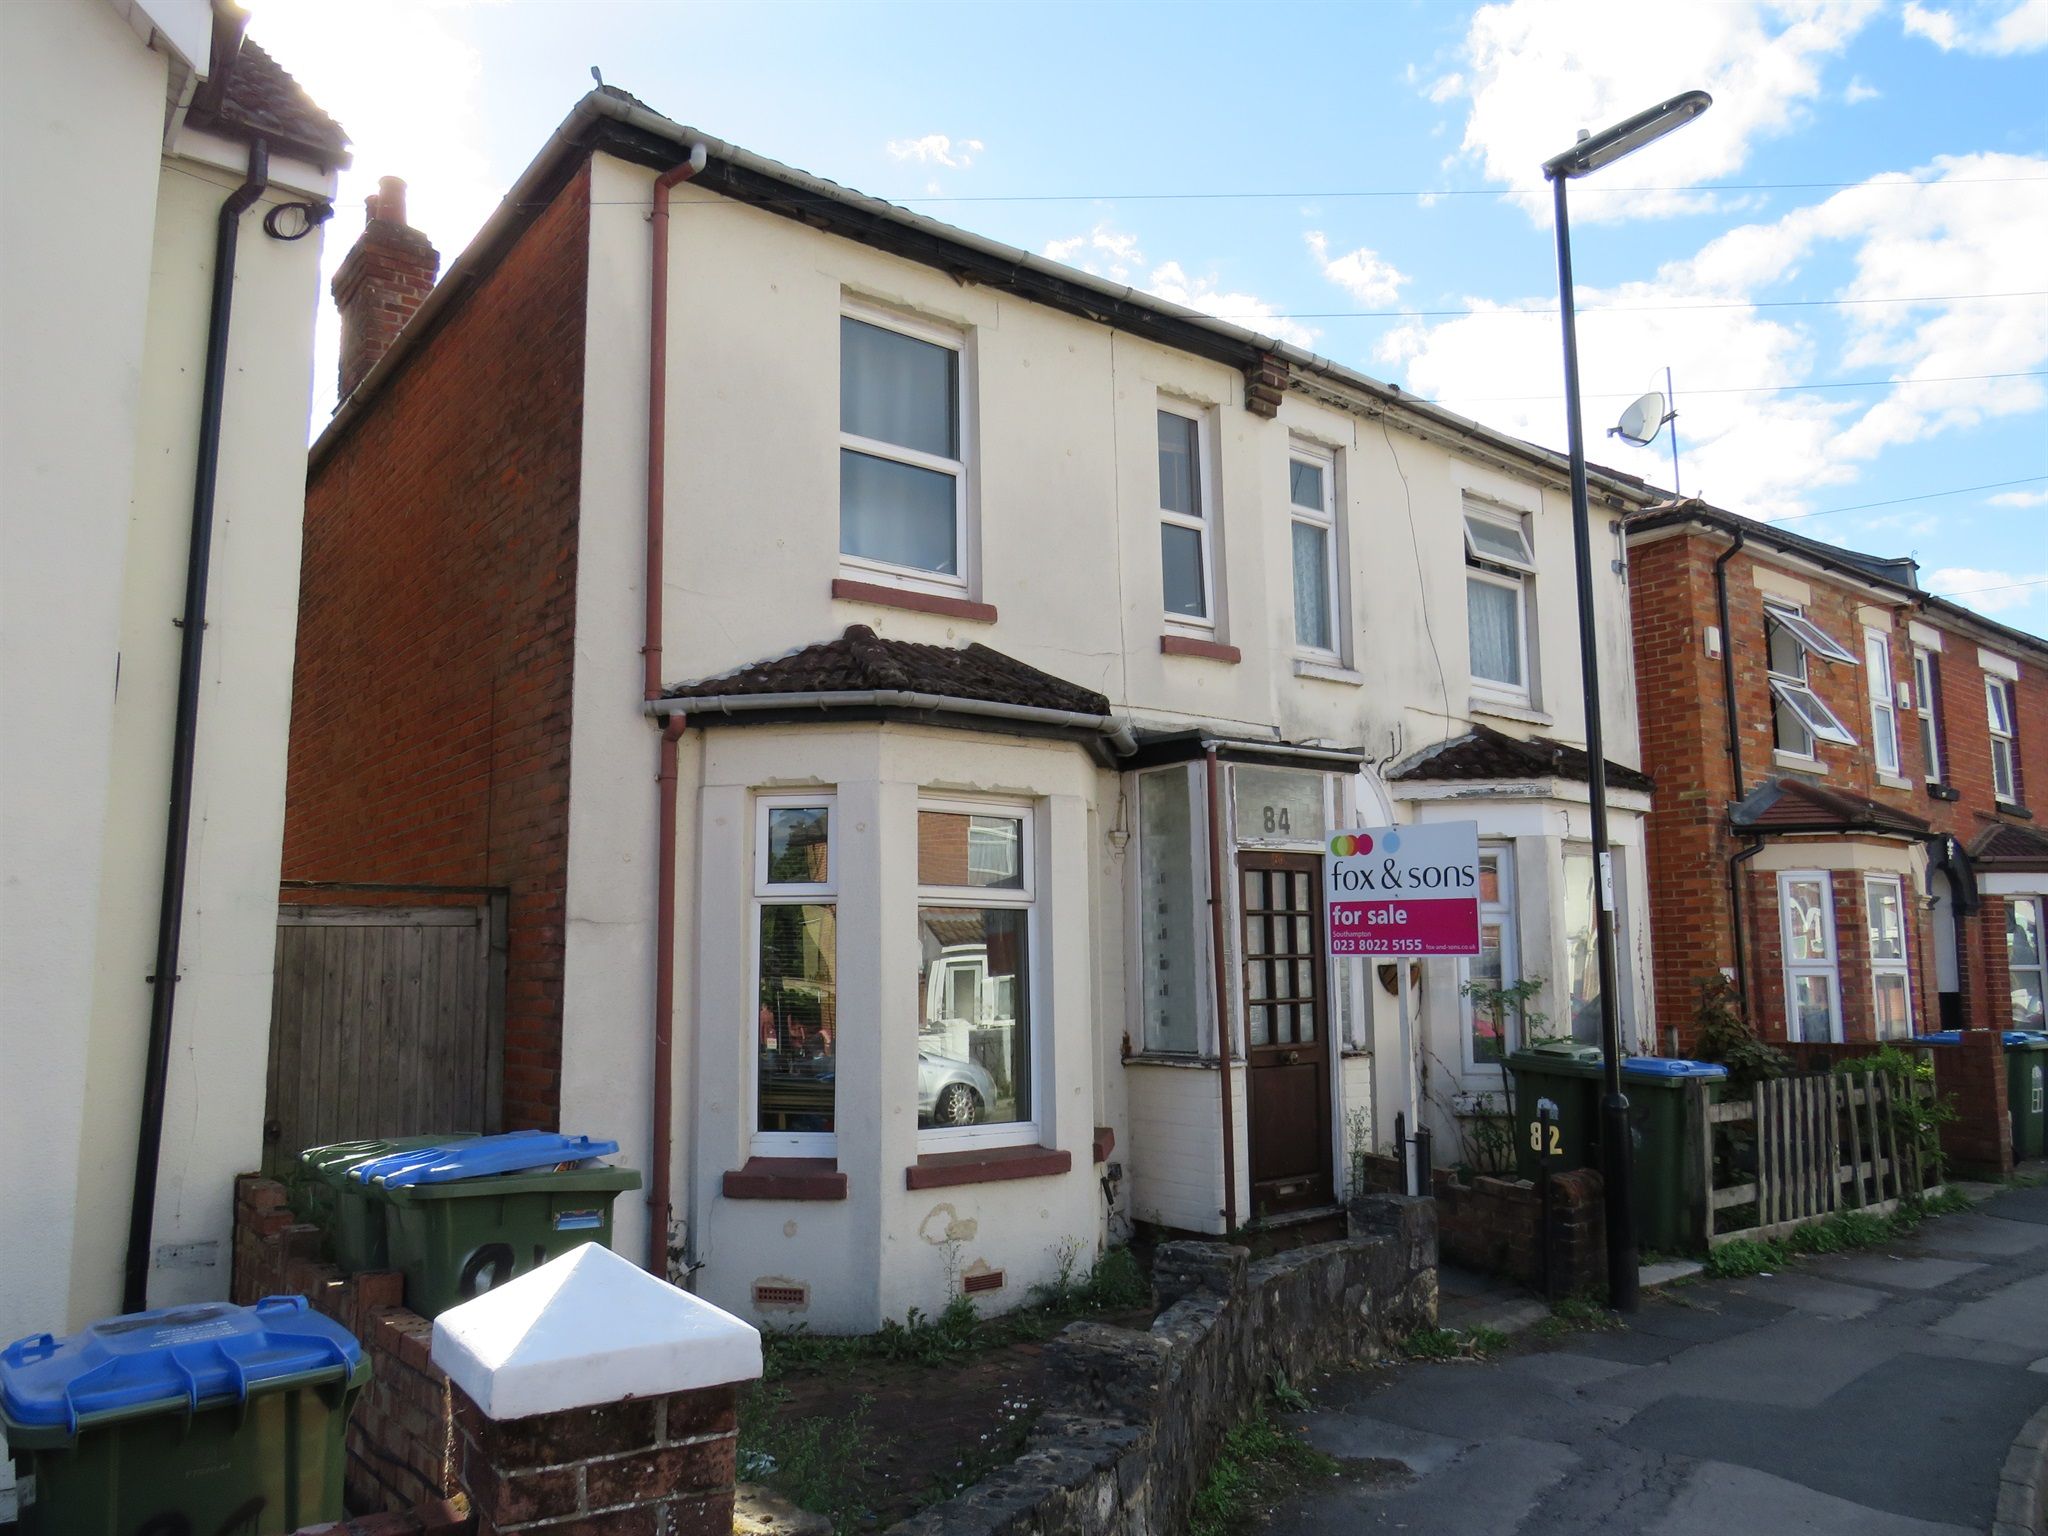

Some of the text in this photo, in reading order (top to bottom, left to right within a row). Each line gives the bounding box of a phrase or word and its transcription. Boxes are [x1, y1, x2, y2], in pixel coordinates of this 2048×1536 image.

[1263, 806, 1290, 834] 84
[1331, 858, 1475, 890] fox & sons
[1332, 904, 1408, 925] for sale
[1333, 939, 1422, 951] 023 8022 5155
[1530, 1121, 1563, 1155] 82
